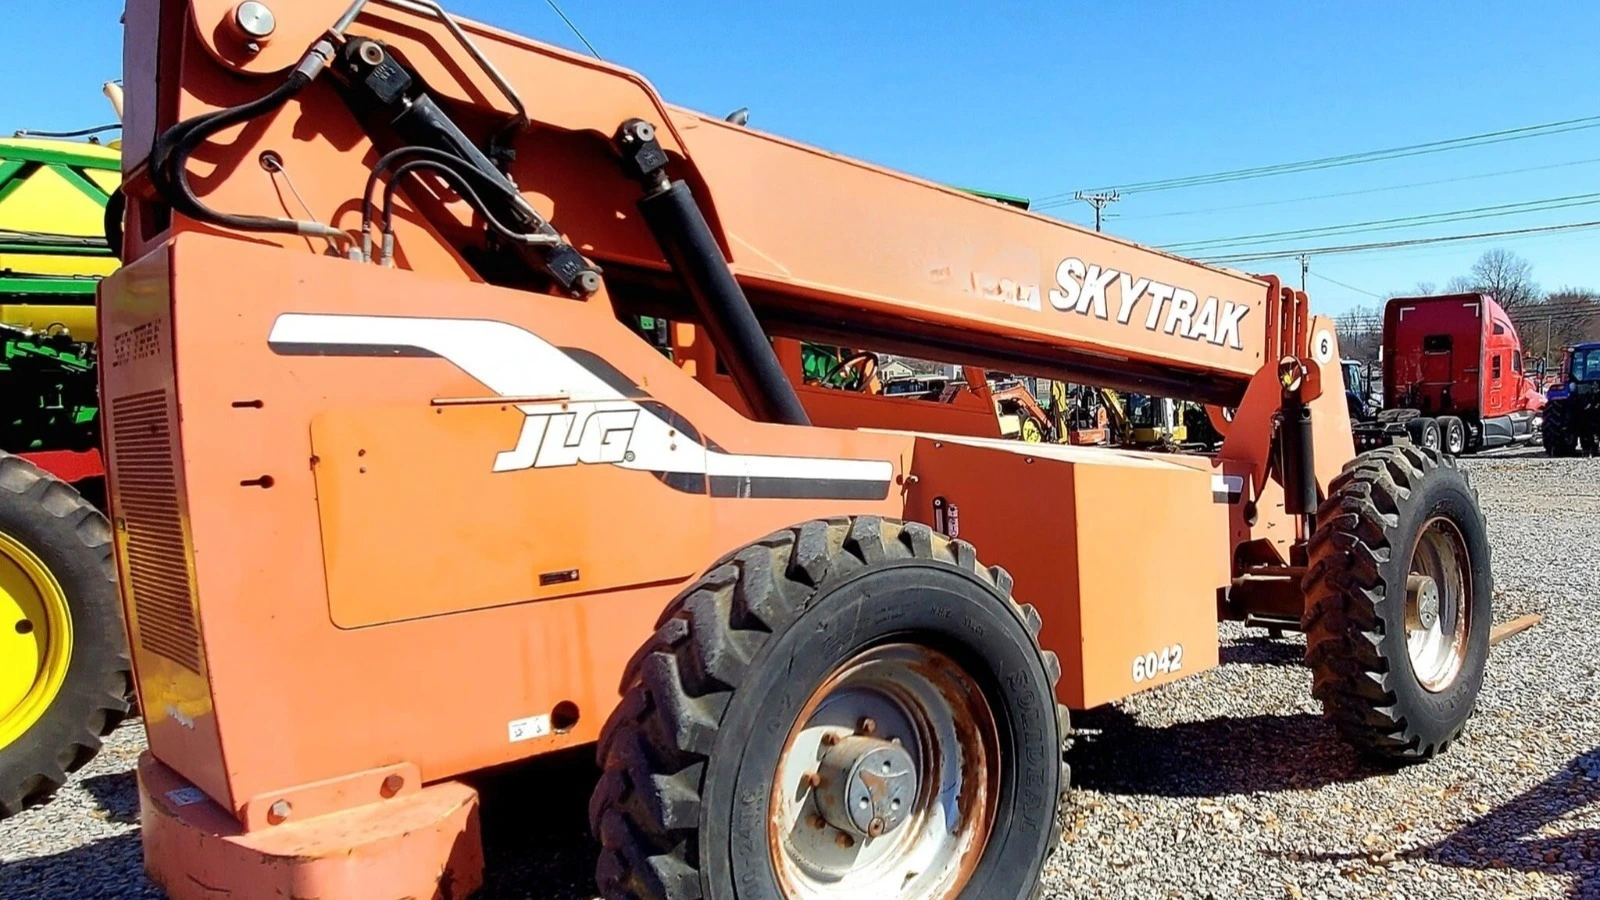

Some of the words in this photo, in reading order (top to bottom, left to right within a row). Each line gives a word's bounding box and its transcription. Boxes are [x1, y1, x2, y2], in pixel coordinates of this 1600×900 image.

[1049, 257, 1249, 350] SKYTRAK
[1320, 338, 1328, 355] 6
[492, 408, 641, 473] JLG
[1132, 643, 1183, 684] 6042
